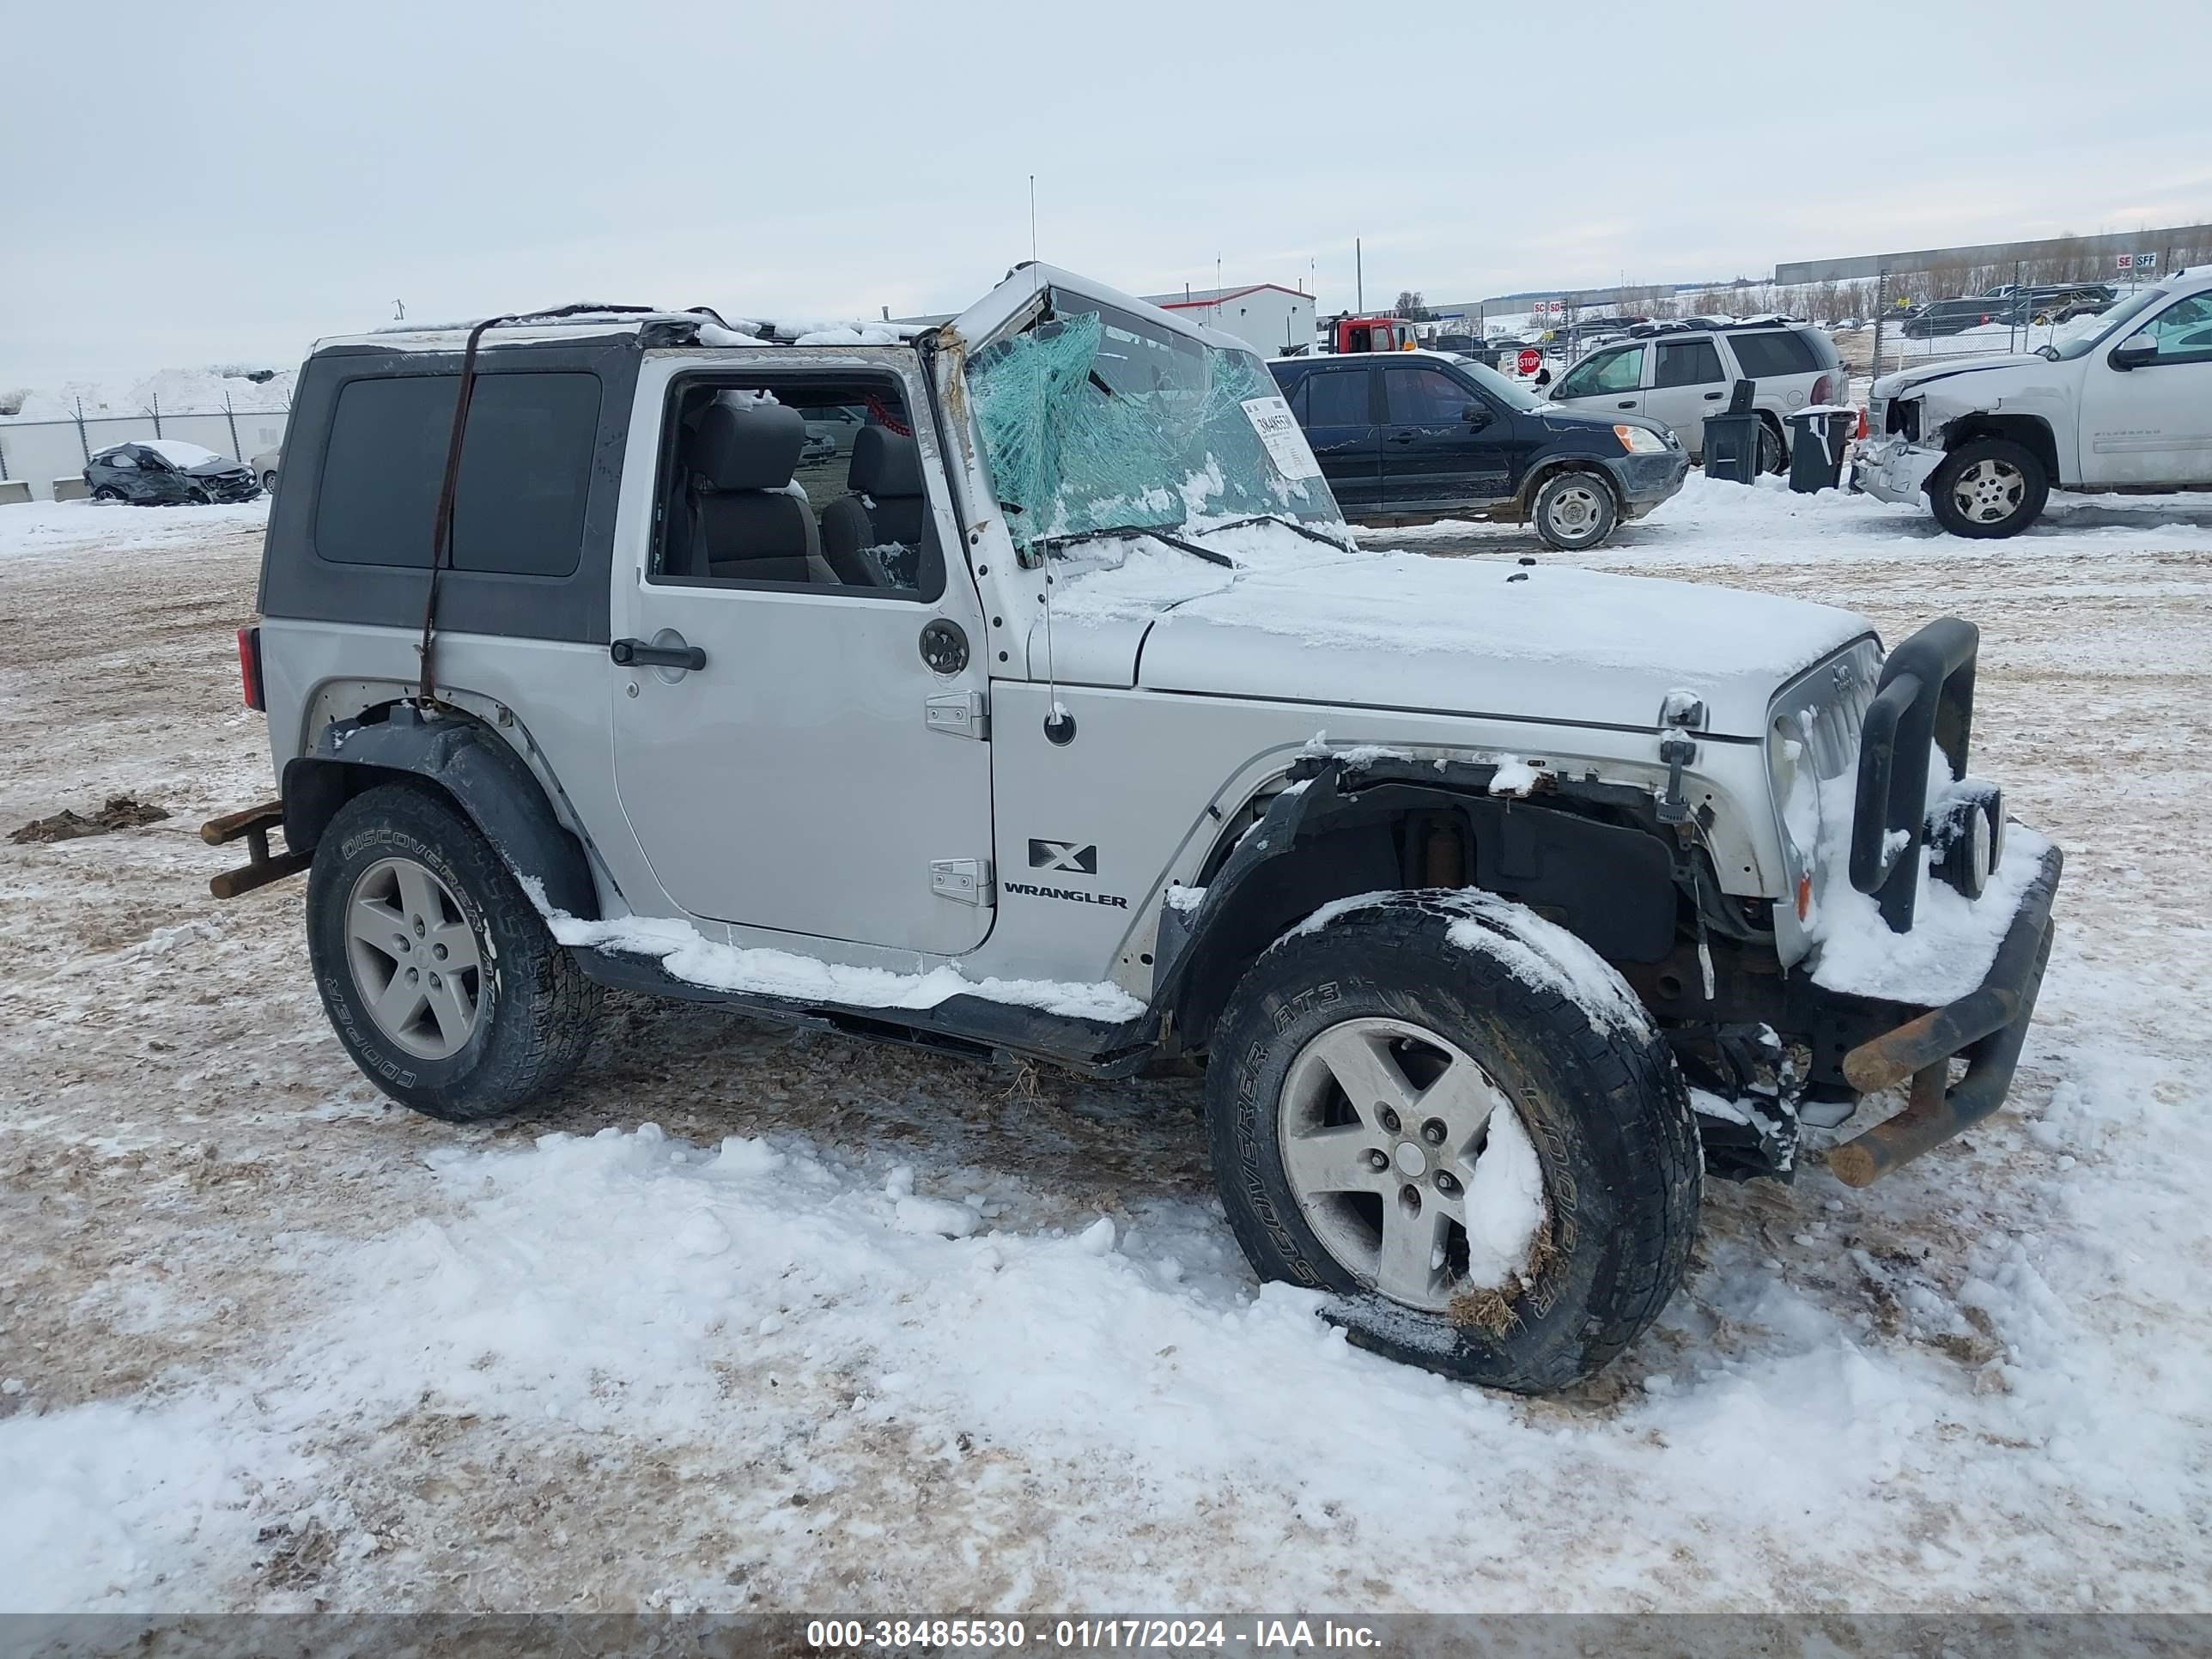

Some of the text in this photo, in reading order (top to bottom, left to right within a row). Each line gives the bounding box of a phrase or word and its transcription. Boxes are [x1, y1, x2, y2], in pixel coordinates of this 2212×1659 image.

[2118, 257, 2131, 267] SE
[2136, 254, 2155, 266] SFF
[1534, 303, 1545, 313] SC
[1550, 303, 1560, 313] SD
[1519, 356, 1539, 368] STOP
[1034, 841, 1093, 872] X
[342, 829, 484, 933] DISCOVERER
[1004, 882, 1128, 909] WRANGLER
[325, 976, 417, 1089] COOPER
[1237, 981, 1341, 1293] SCOVERER AT3
[1518, 1087, 1578, 1320] COOPR
